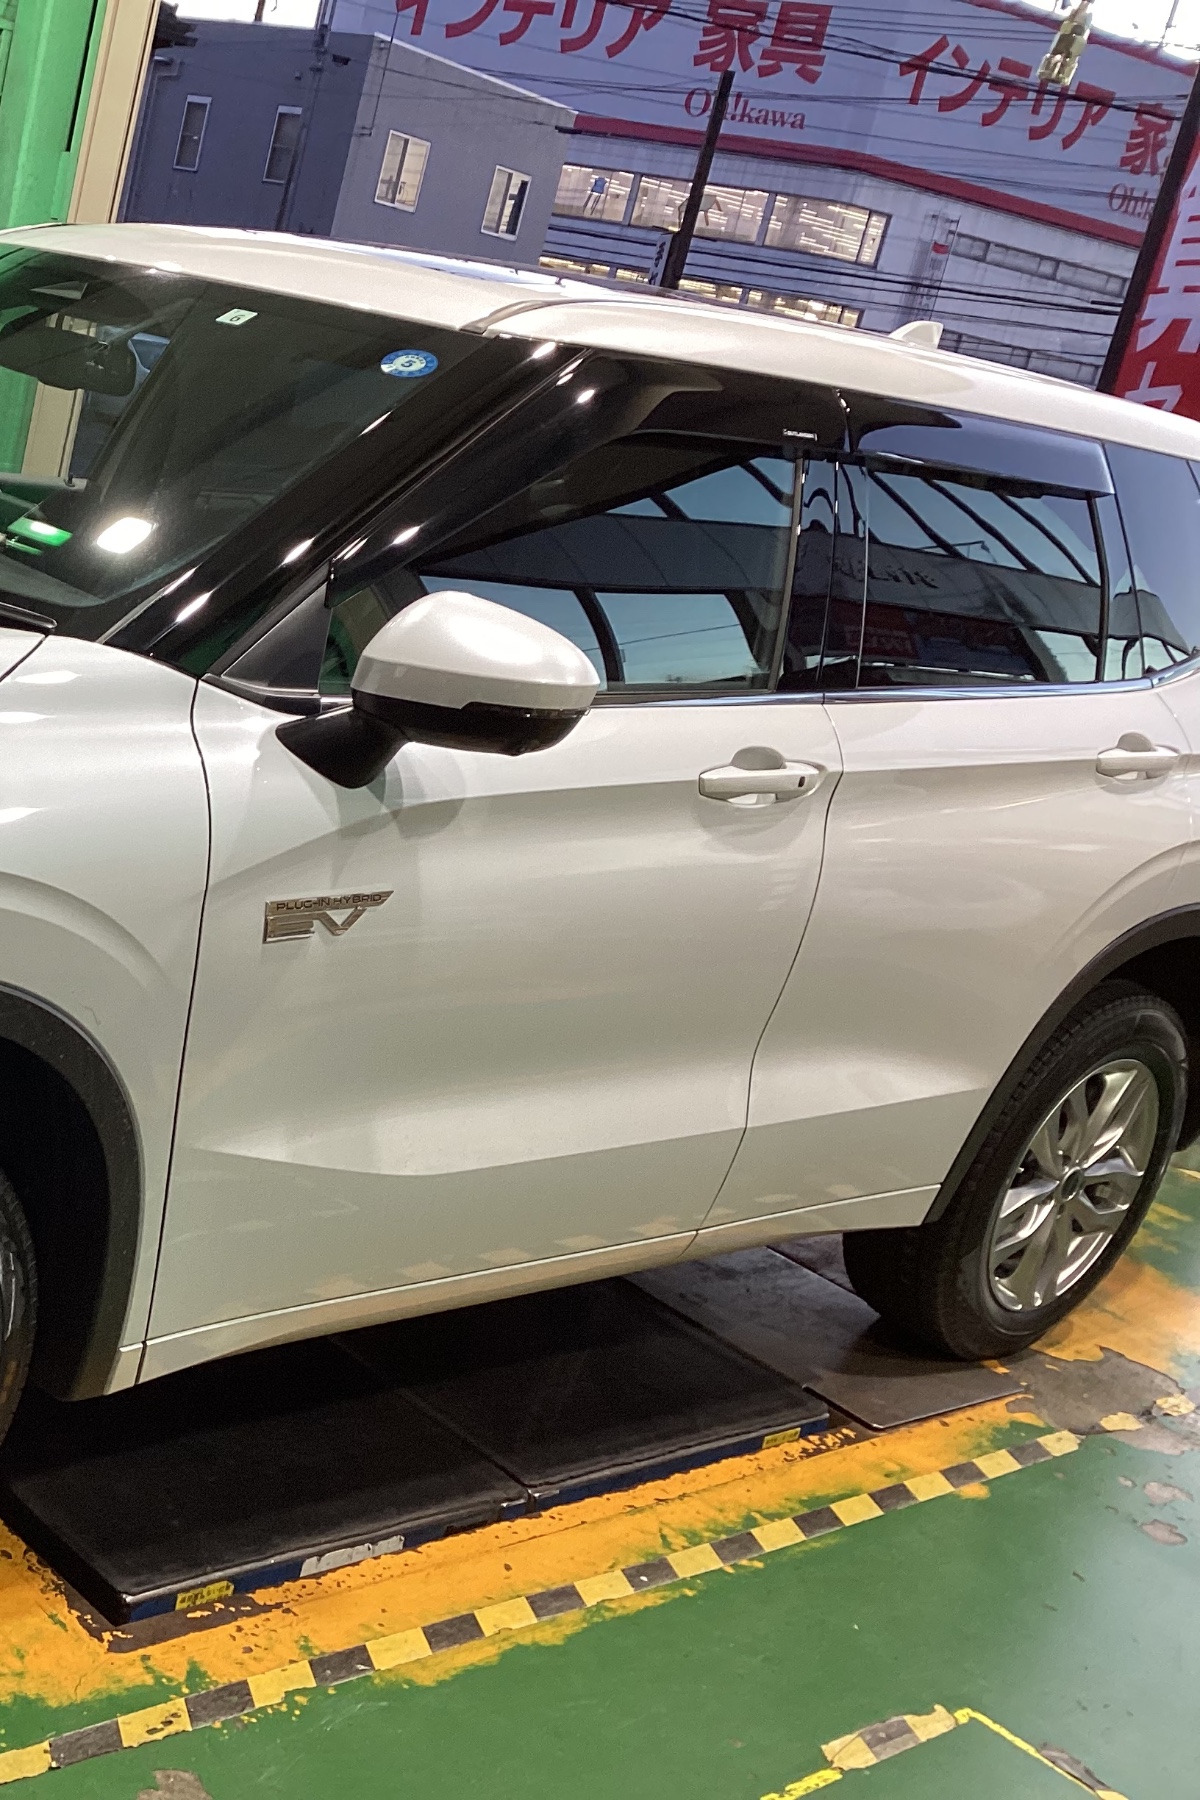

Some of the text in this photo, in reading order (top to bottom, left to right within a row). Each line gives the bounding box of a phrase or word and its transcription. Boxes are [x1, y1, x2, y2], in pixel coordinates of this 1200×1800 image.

[693, 0, 833, 84] 家具
[684, 87, 806, 130] O!kawa
[899, 34, 1175, 178] インテリア 家
[401, 359, 417, 368] 5
[276, 893, 383, 912] PLUG-IN HYBRID
[262, 905, 368, 944] EV
